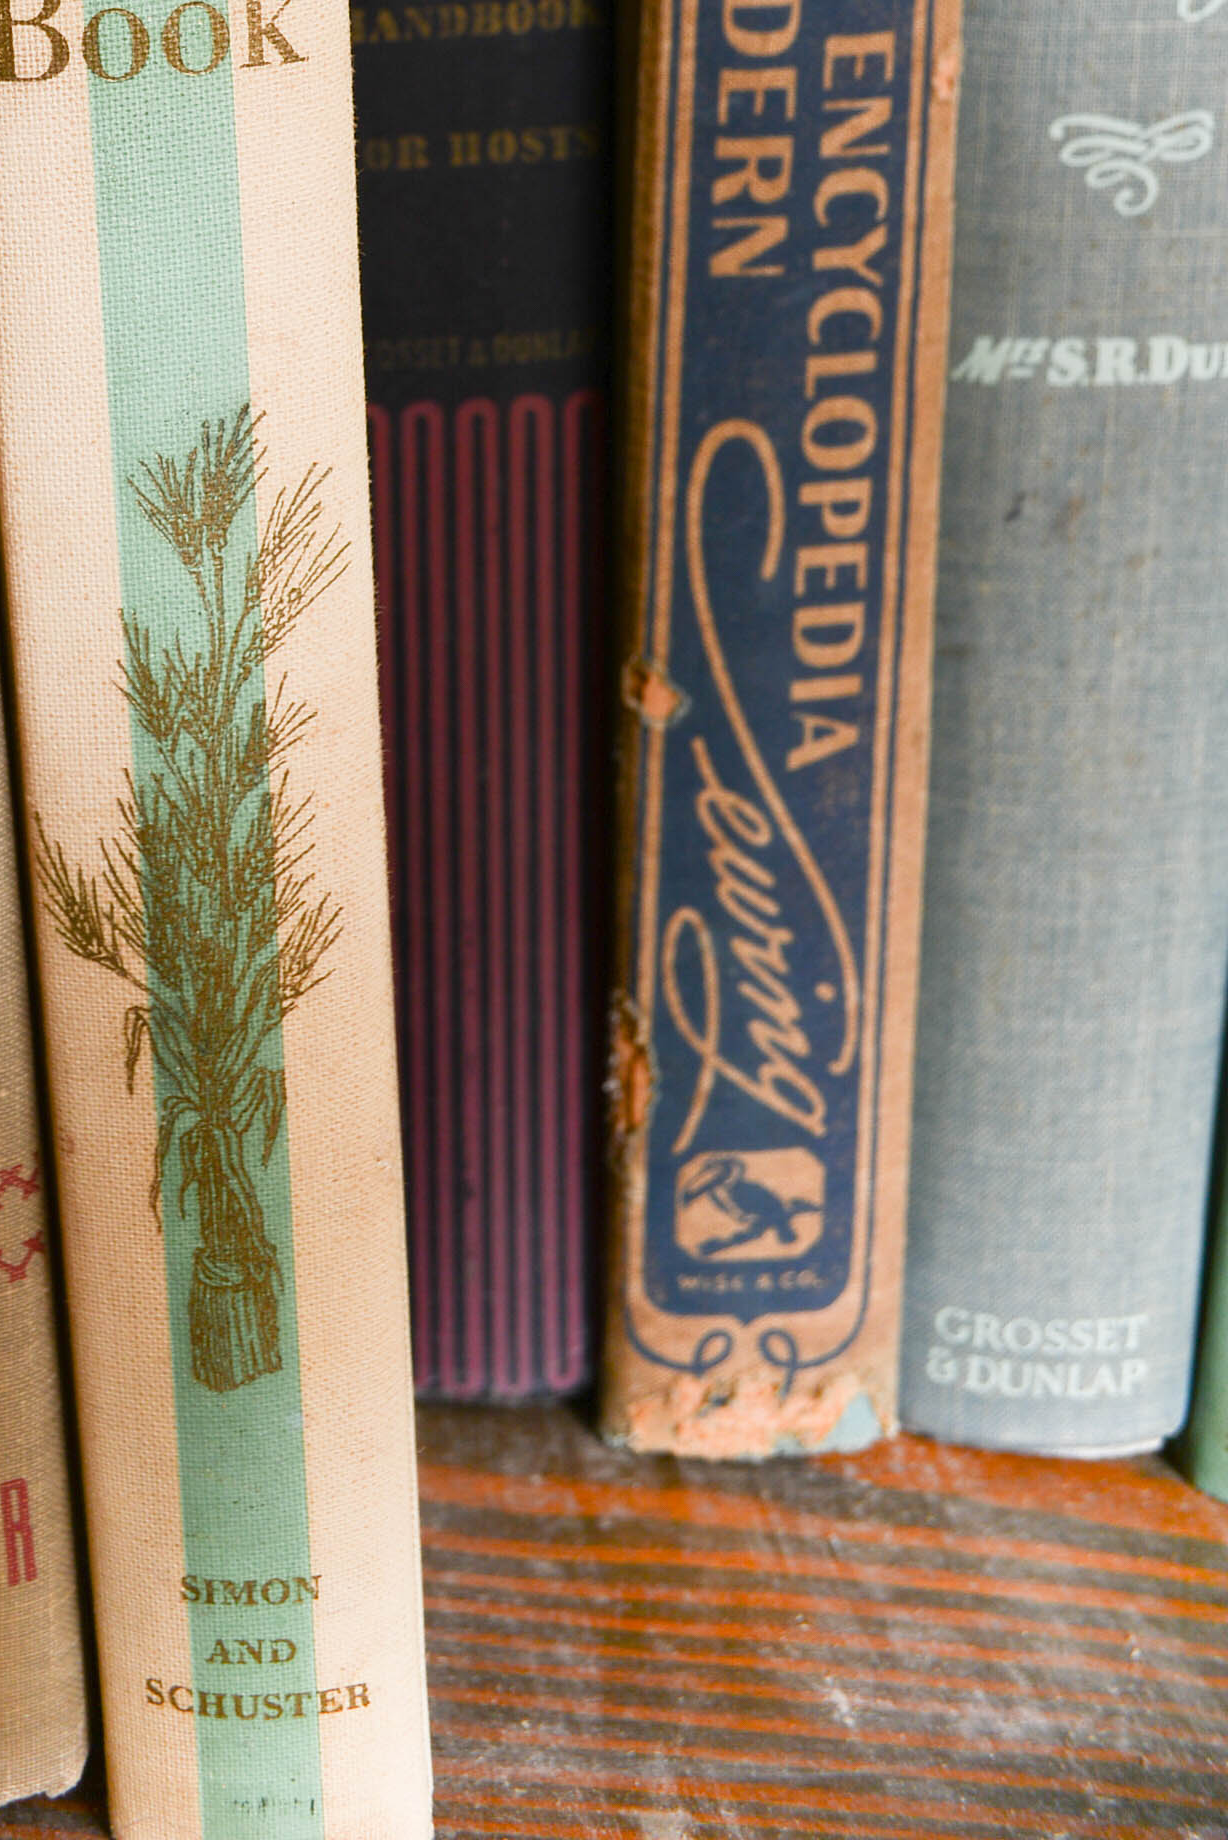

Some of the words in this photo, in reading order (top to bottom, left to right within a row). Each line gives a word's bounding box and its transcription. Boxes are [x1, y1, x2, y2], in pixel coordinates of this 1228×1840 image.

[448, 125, 602, 169] HOSTS
[785, 29, 897, 772] ENCYCLOPEDIA
[661, 417, 861, 1156] Sewing
[934, 1305, 1150, 1357] GROSSET
[925, 1345, 960, 1385] &
[964, 1353, 1149, 1400] DUNLAP
[179, 1573, 323, 1607] SIMON
[204, 1637, 298, 1665] AND
[144, 1676, 372, 1721] SCHUSTER
